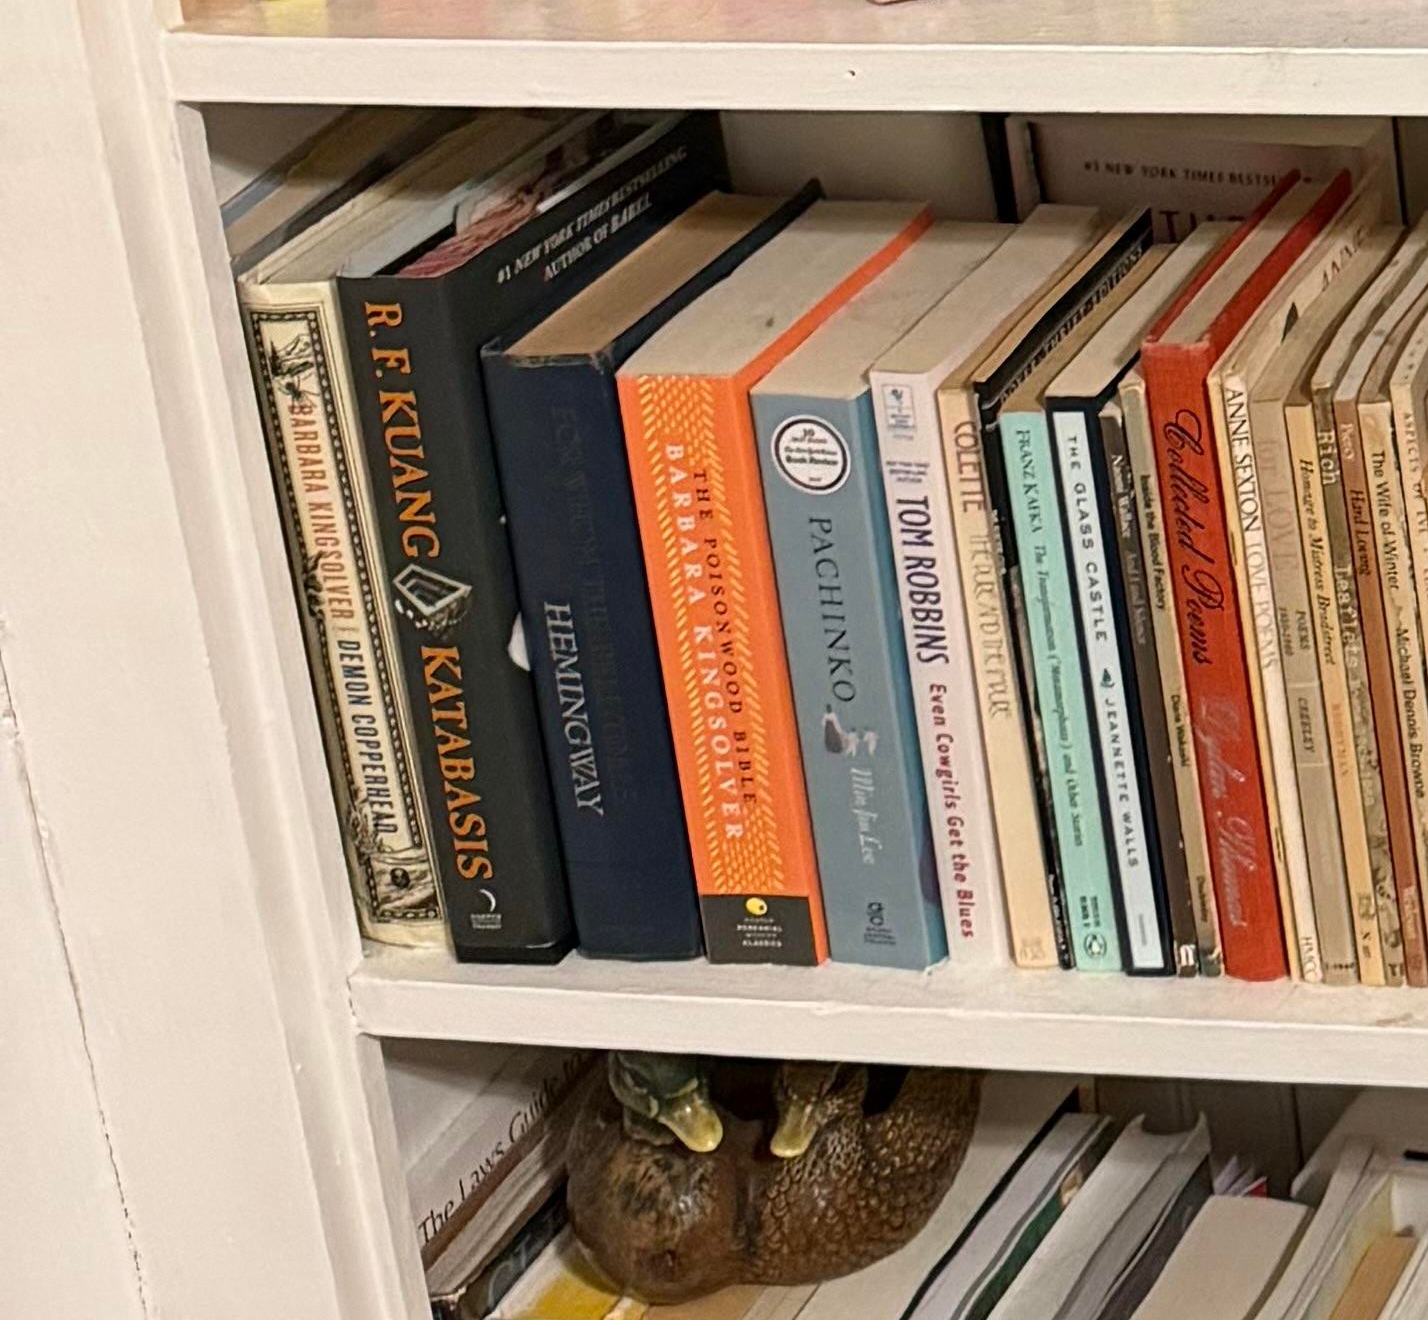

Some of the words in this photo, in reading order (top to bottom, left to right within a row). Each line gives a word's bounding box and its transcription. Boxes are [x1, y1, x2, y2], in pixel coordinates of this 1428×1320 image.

[808, 517, 857, 705] PACHINKO
[896, 496, 935, 548] TOM
[904, 556, 950, 665] ROBBINS
[703, 536, 745, 715] POISONWOOD
[421, 646, 494, 881] KATABASIS
